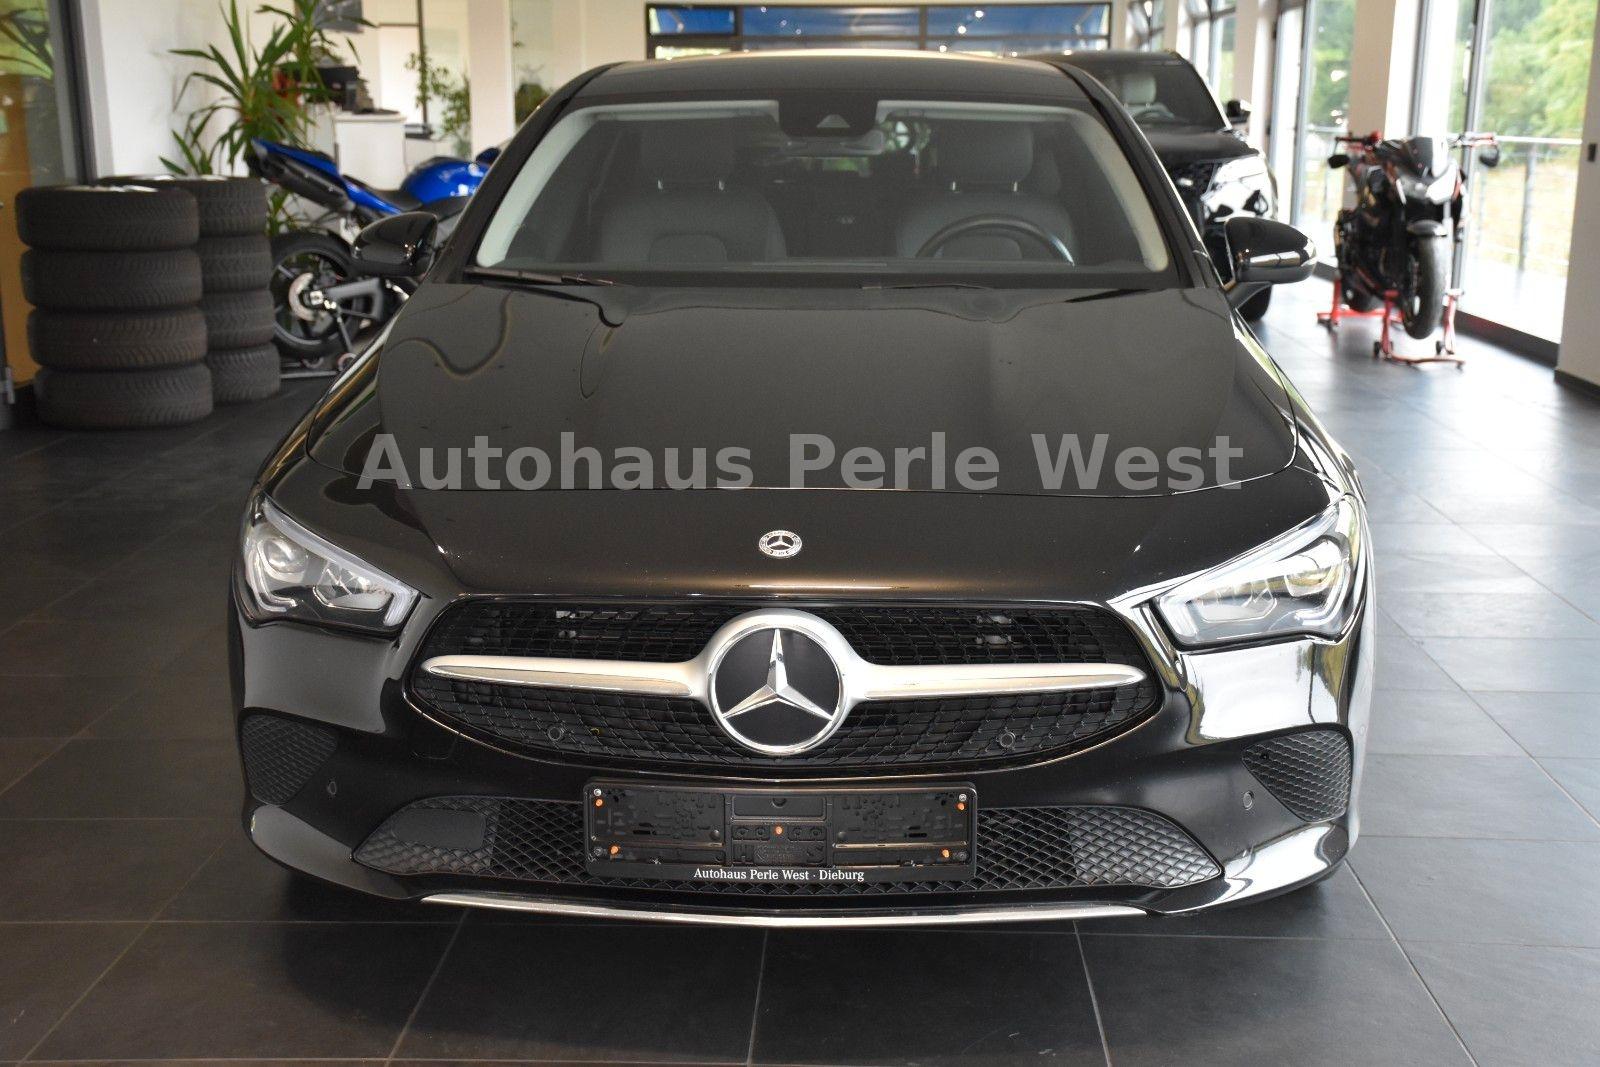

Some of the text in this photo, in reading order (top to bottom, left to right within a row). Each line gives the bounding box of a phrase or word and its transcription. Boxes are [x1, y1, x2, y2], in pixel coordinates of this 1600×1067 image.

[693, 868, 747, 880] Autohaus
[750, 869, 779, 880] Perle
[781, 870, 809, 881] West
[818, 869, 865, 882] Dieburg
